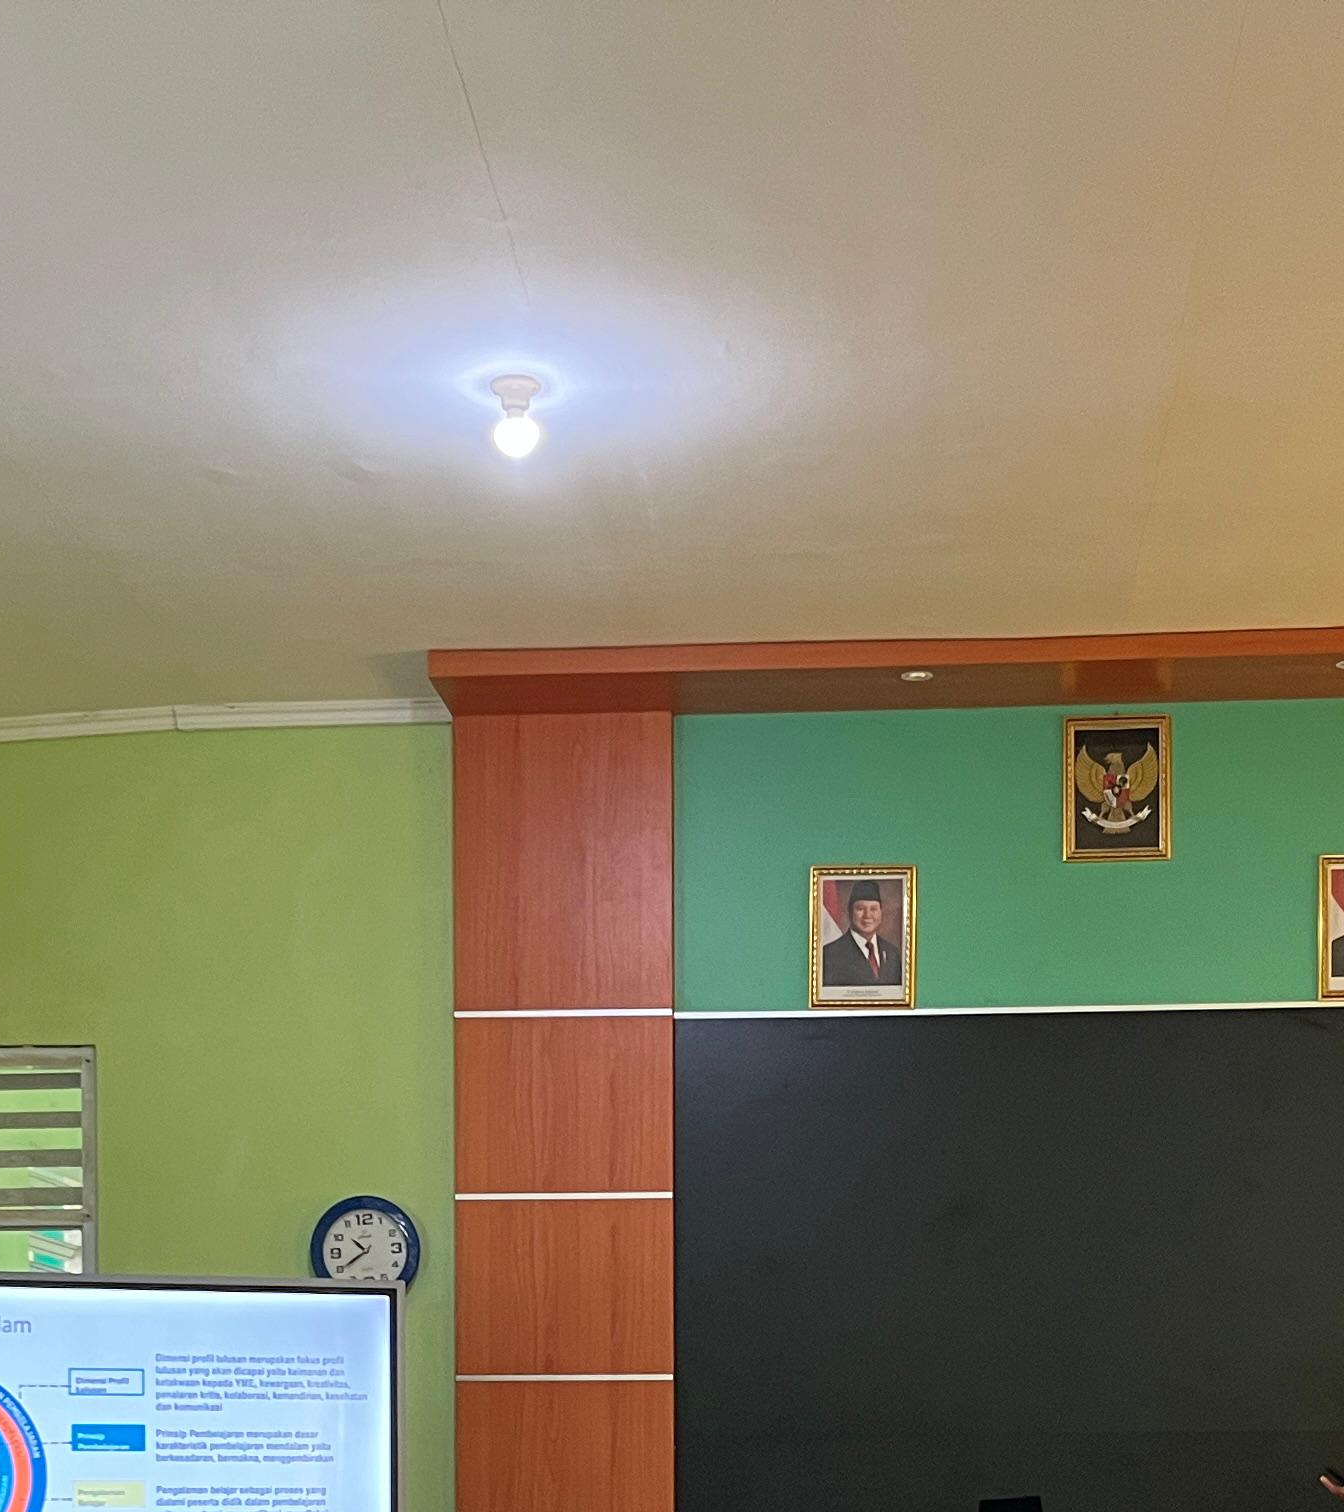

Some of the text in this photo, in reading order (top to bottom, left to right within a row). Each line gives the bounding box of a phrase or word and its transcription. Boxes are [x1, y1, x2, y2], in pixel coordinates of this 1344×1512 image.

[355, 1213, 373, 1226] 12
[330, 1248, 341, 1259] 9
[391, 1242, 402, 1254] 3
